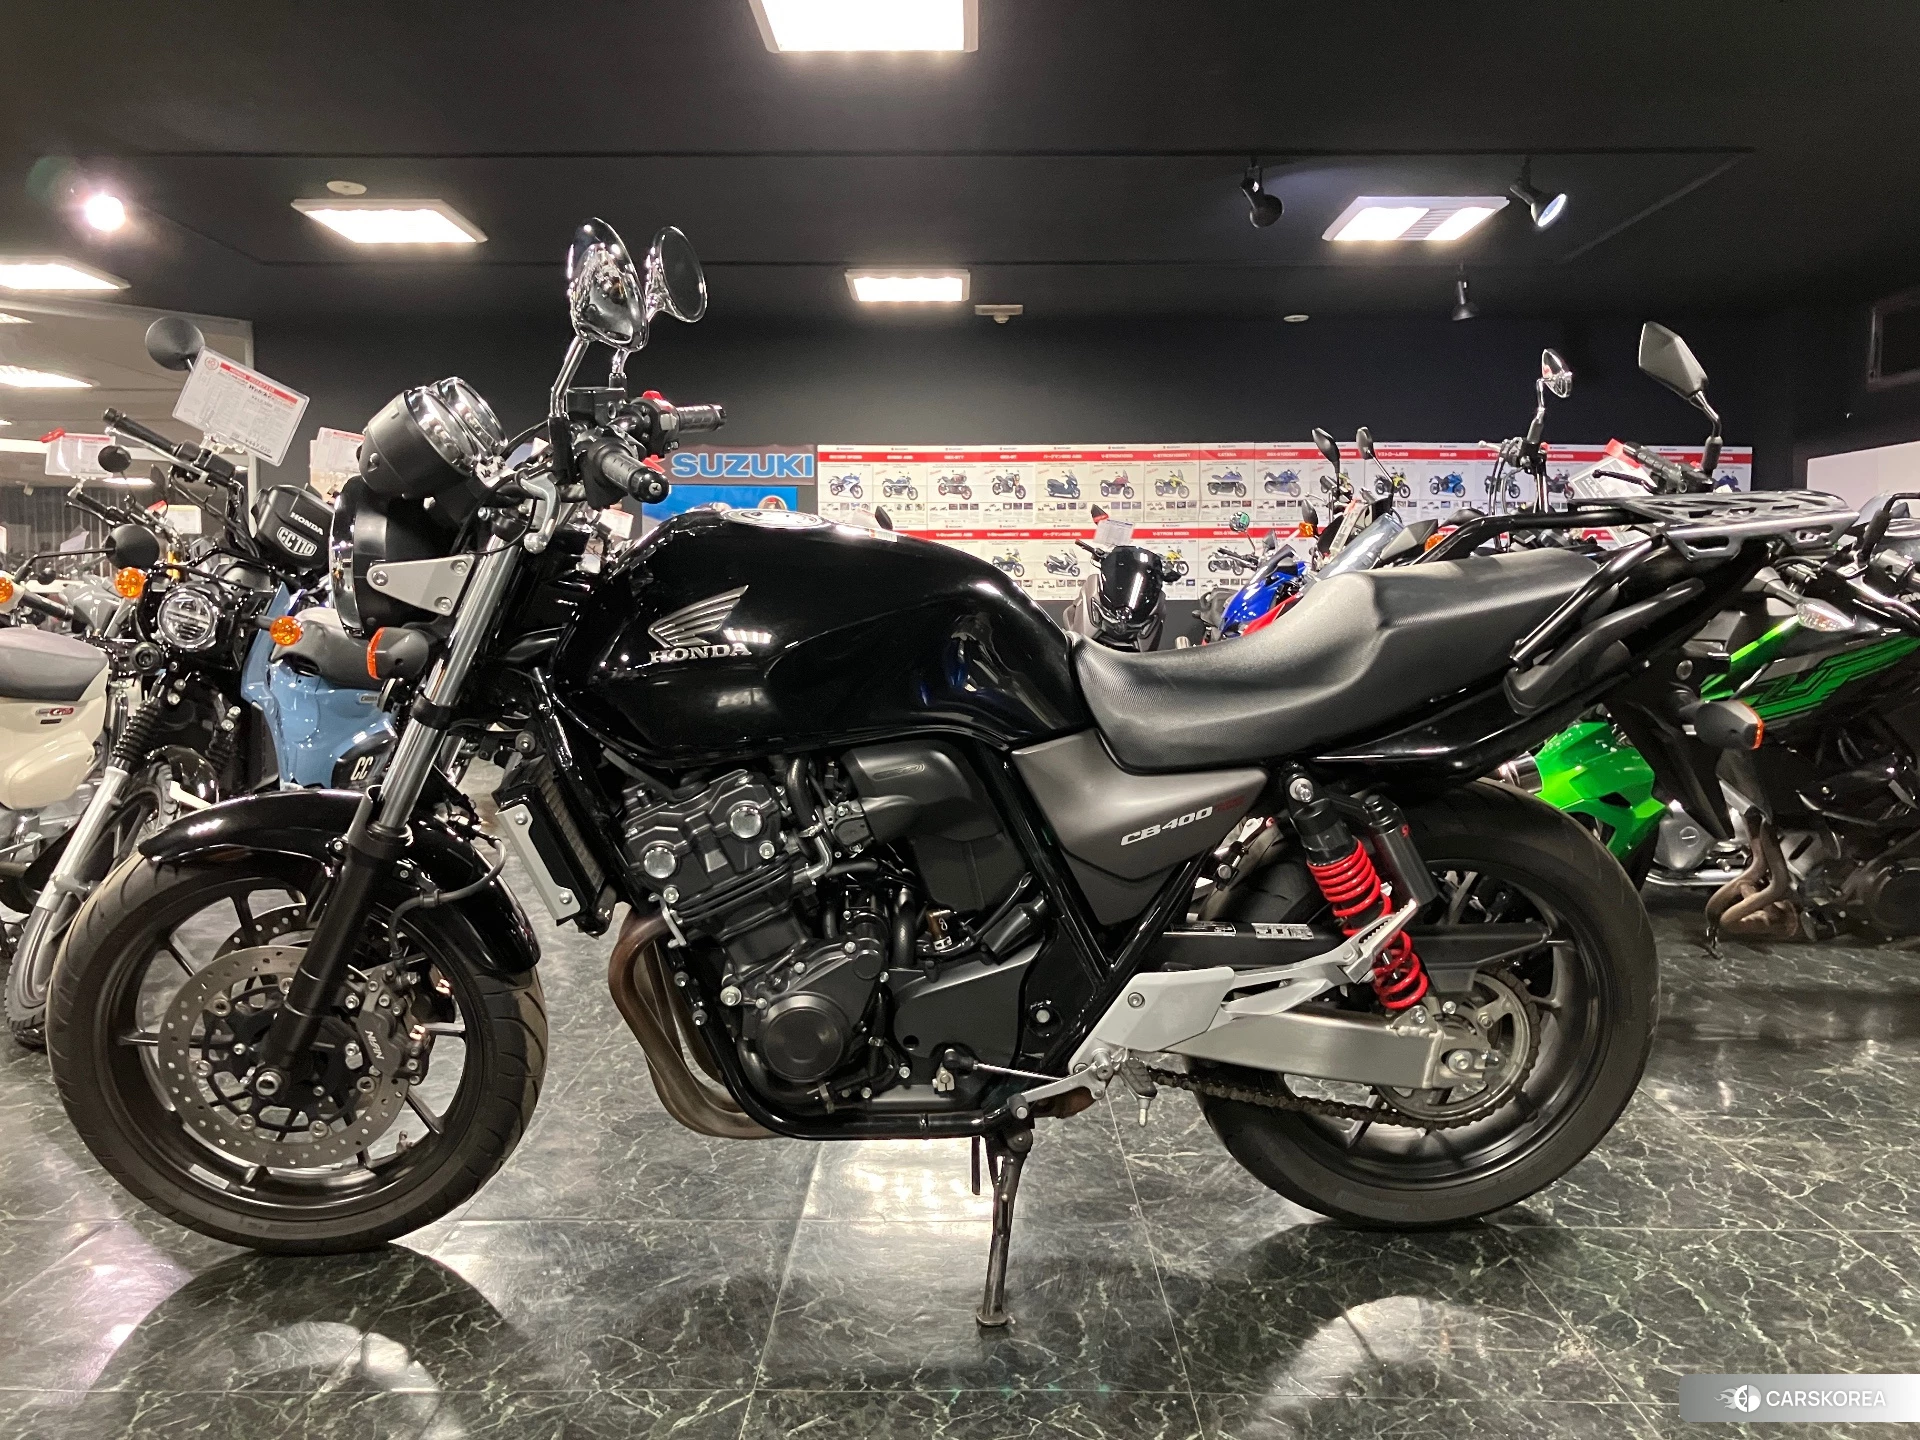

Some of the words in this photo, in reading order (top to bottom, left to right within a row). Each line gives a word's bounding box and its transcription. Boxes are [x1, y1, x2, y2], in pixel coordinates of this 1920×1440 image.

[671, 452, 815, 478] SUZUKI
[290, 511, 324, 536] HONDA
[279, 527, 315, 555] CC110
[648, 642, 753, 664] HONDA
[1120, 806, 1213, 846] CB400
